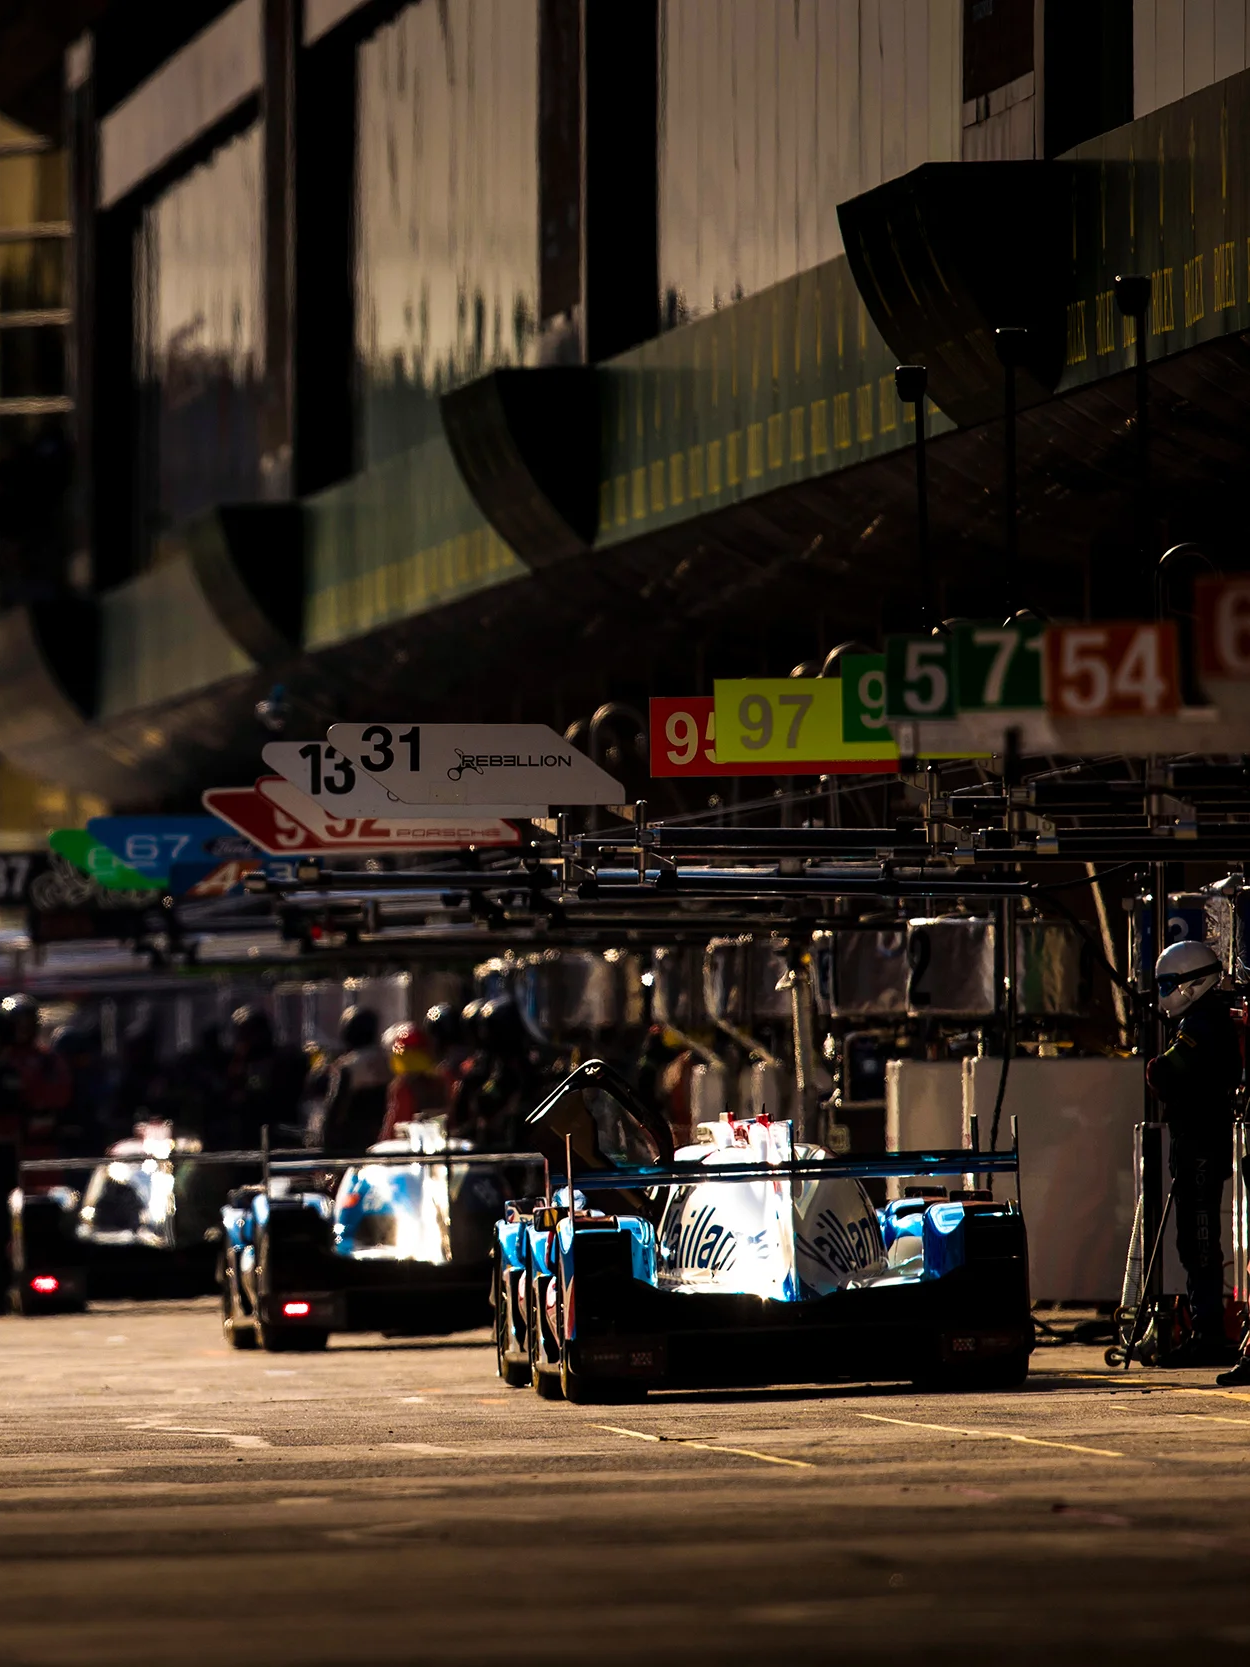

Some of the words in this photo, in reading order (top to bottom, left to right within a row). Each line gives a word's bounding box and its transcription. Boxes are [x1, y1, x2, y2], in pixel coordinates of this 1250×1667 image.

[1059, 624, 1167, 715] 54
[738, 693, 813, 750] 97
[299, 744, 356, 795] 13
[360, 725, 421, 772] 31
[461, 755, 572, 768] REBELLION
[124, 833, 191, 860] 67
[396, 828, 502, 838] PORSCHE
